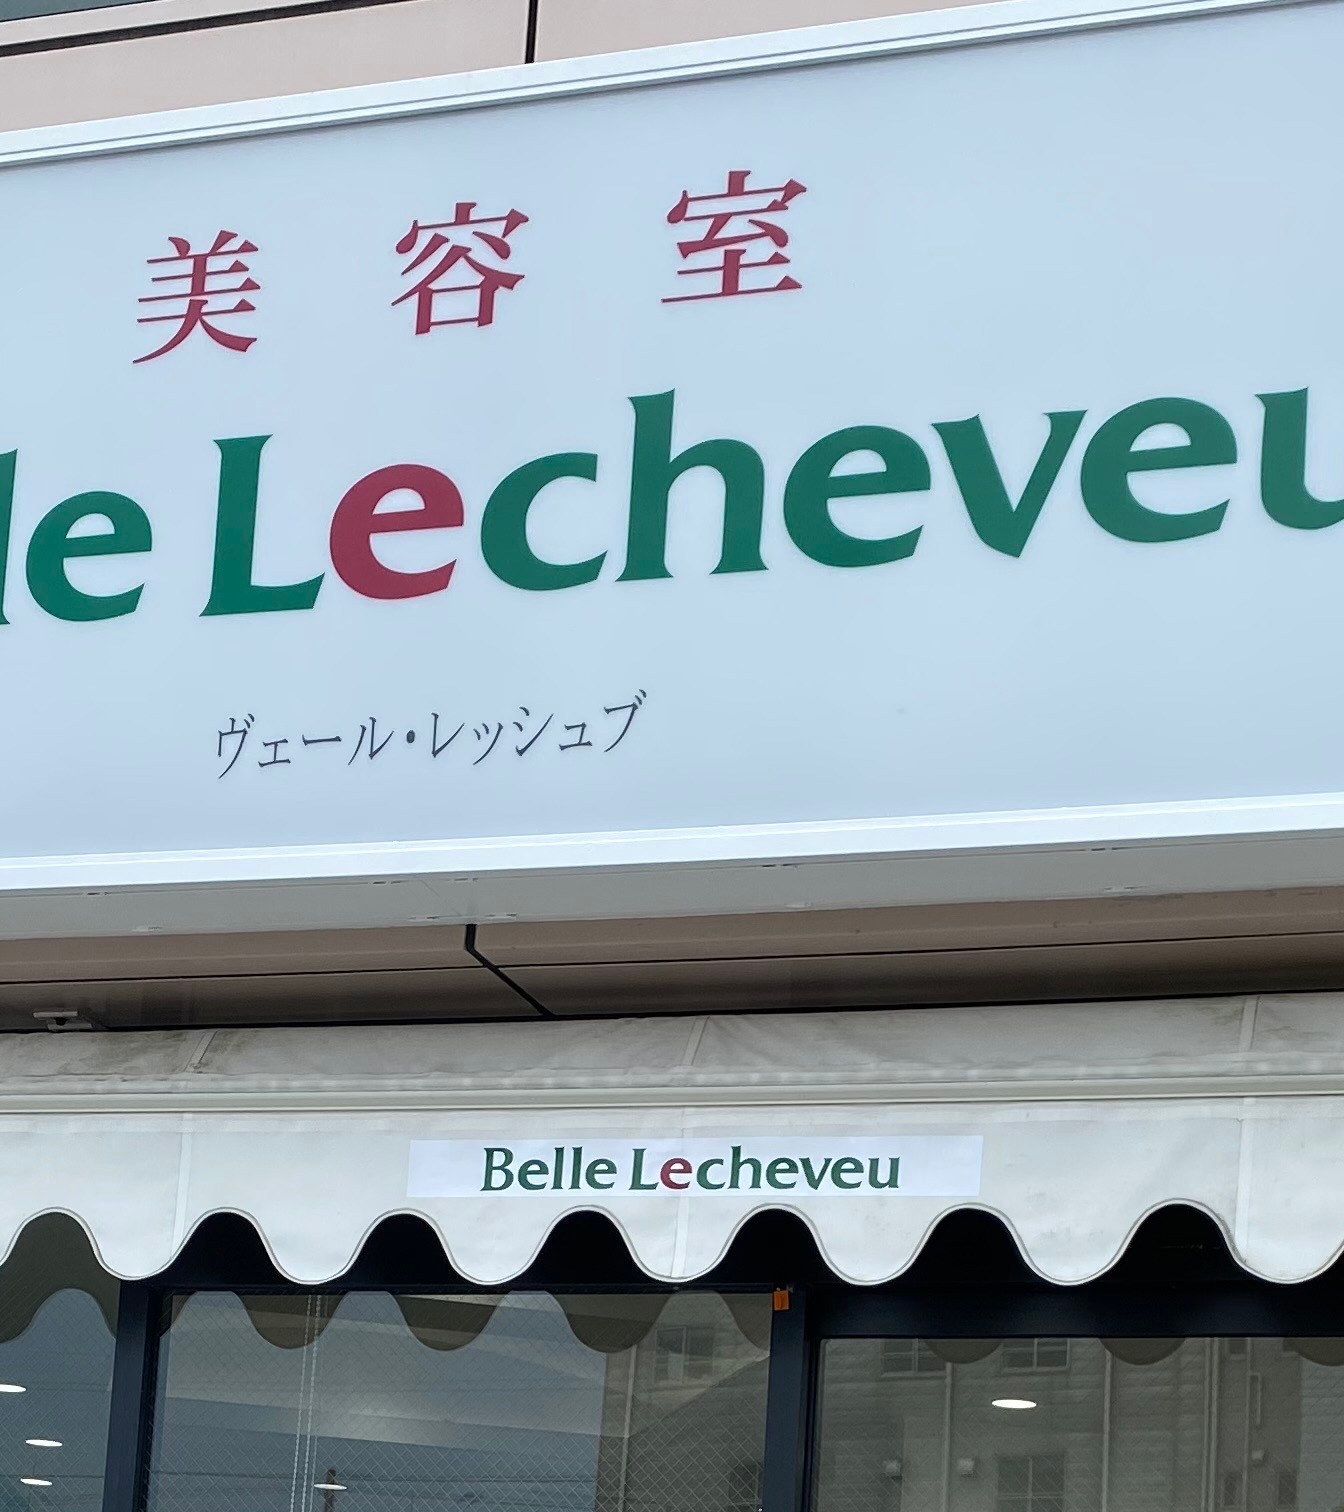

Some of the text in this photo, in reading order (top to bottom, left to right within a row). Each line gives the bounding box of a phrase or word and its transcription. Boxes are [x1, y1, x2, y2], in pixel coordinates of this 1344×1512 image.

[132, 167, 810, 364] 美容室
[213, 688, 648, 781] ヴェール・レッシュブ
[479, 1146, 902, 1192] Belle Lecheveu
